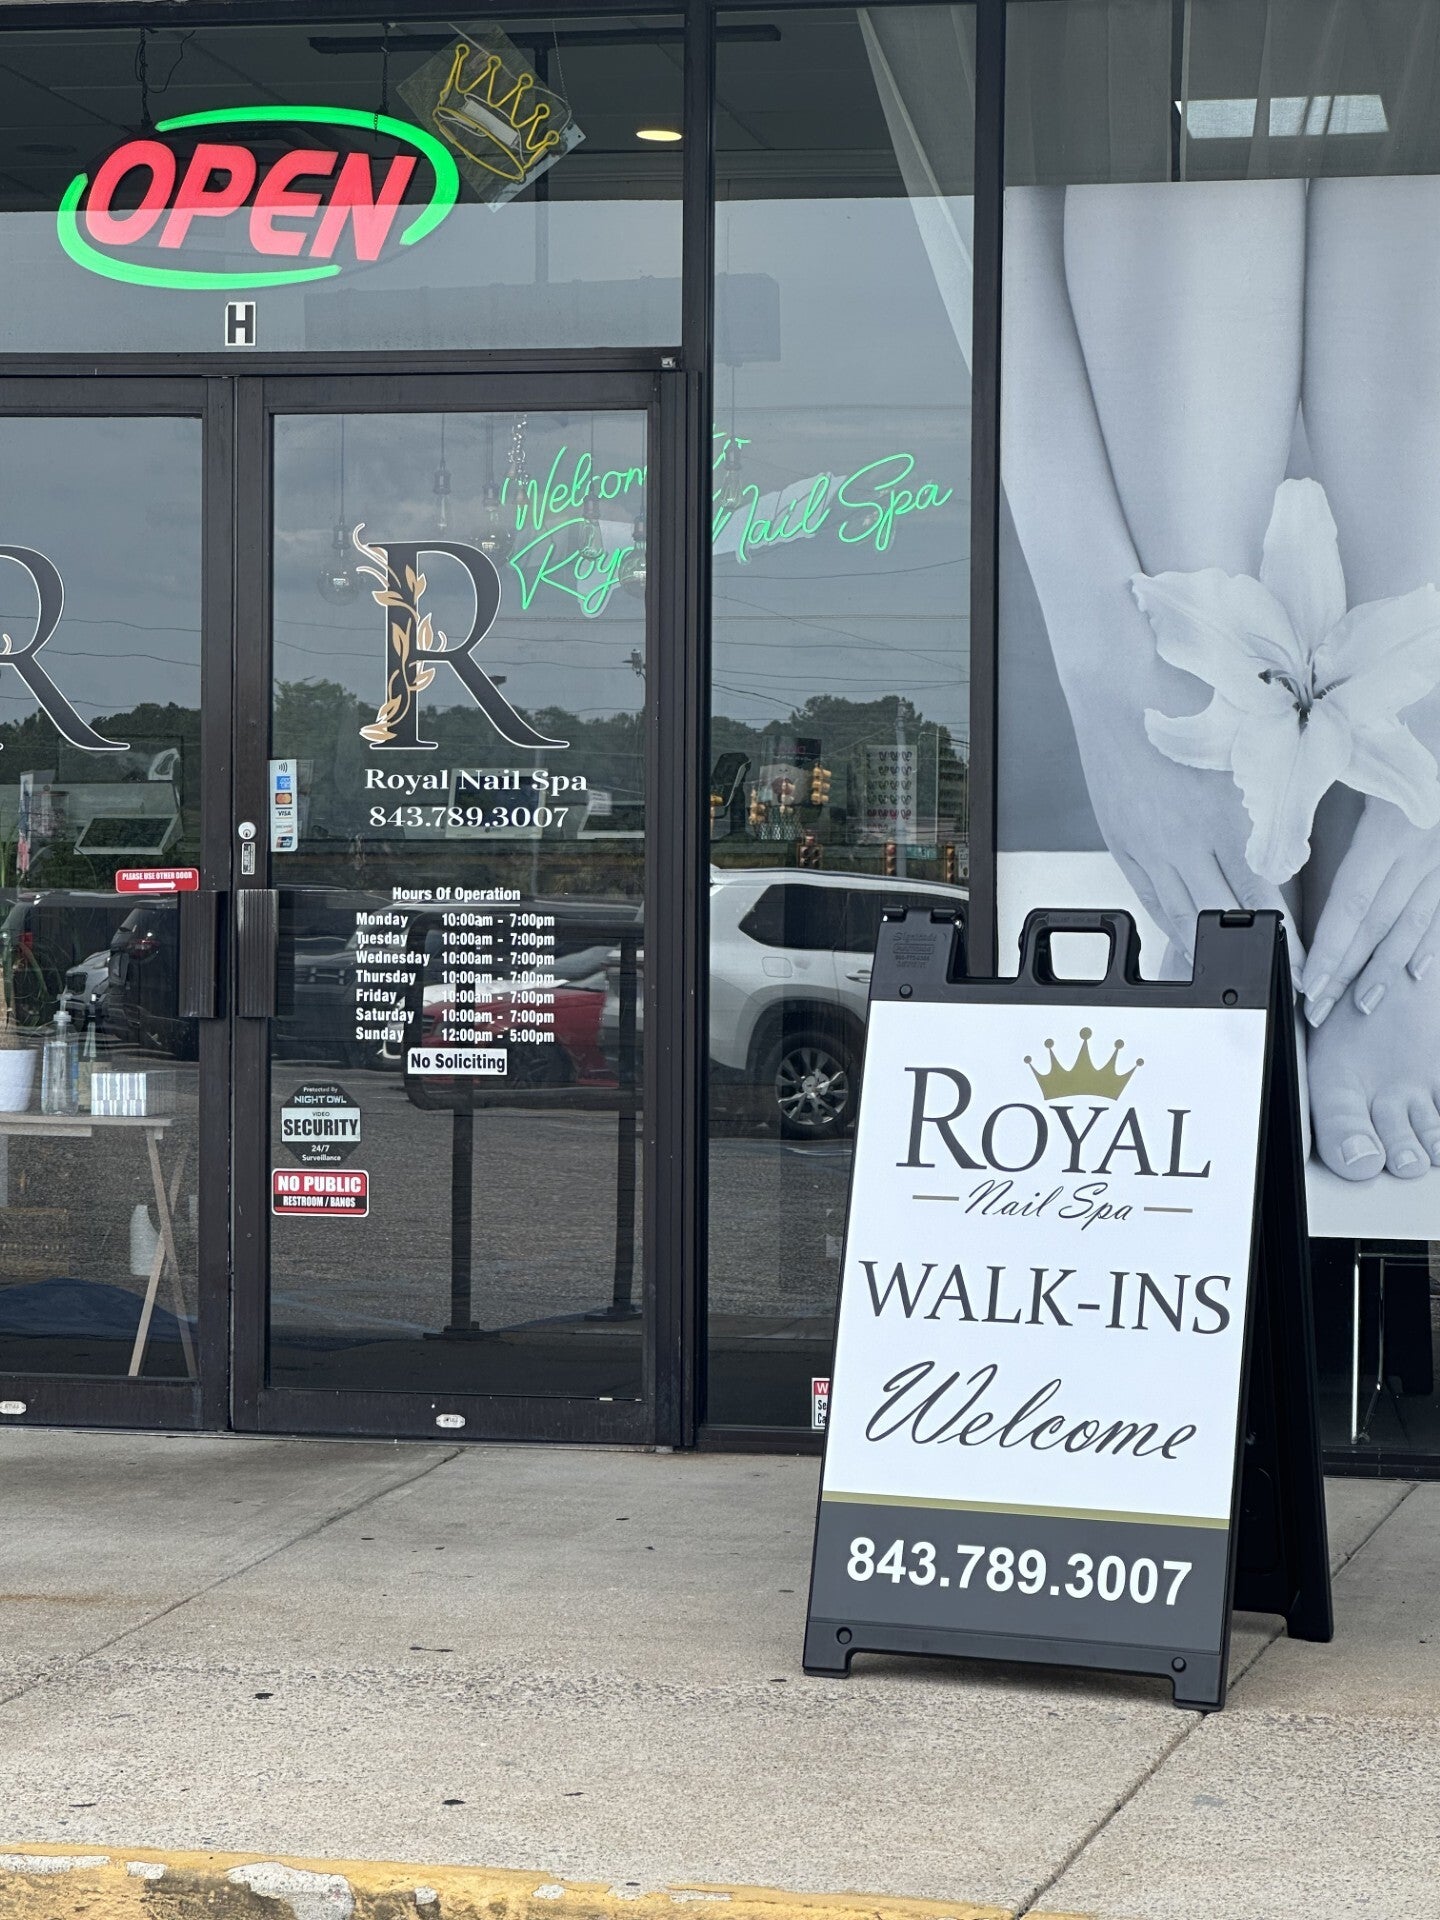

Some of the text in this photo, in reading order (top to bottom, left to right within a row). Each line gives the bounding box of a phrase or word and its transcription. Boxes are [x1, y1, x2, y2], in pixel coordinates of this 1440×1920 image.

[85, 139, 417, 261] OPEN
[226, 303, 255, 345] H
[838, 453, 953, 551] Spa
[360, 530, 571, 750] R
[364, 768, 588, 797] Royal Nail Spa
[369, 806, 570, 828] 843.789.3007
[122, 871, 192, 881] PLEASE USE OTHER DOOR
[392, 886, 521, 903] Hours Of Operation
[356, 912, 408, 927] Monday
[442, 913, 493, 926] 10:00am
[510, 913, 555, 929] 7:00pm
[356, 932, 408, 947] Tuesday
[442, 932, 493, 946] 10:00am
[510, 933, 555, 948] 7:00pm
[356, 951, 430, 966] Wednesday
[442, 952, 493, 965] 10:00am
[510, 952, 555, 968] 7:00pm
[356, 970, 416, 985] Thursday
[442, 971, 493, 984] 10:00am
[510, 971, 555, 987] 7:00pm
[356, 989, 397, 1004] Friday
[442, 990, 493, 1003] 10:00am
[510, 990, 555, 1006] 7:00pm
[356, 1008, 415, 1024] Saturday
[442, 1009, 493, 1022] 10:00am
[510, 1009, 555, 1025] 7:00pm
[356, 1027, 404, 1043] Sunday
[442, 1028, 493, 1044] 12:00pm
[510, 1028, 555, 1044] 5:00pm
[411, 1053, 506, 1073] No Soliciting
[294, 1095, 347, 1104] NIGHT OWL
[283, 1118, 358, 1136] SECURITY
[311, 1144, 330, 1152] 24/7
[278, 1175, 361, 1193] NO PUBLIC
[283, 1196, 324, 1208] RESTROOM
[964, 1179, 1133, 1231] Nail Spa
[858, 1260, 1232, 1335] WALK-INS
[865, 1360, 1197, 1459] Welcome
[846, 1536, 1193, 1606] 843.789.3007
